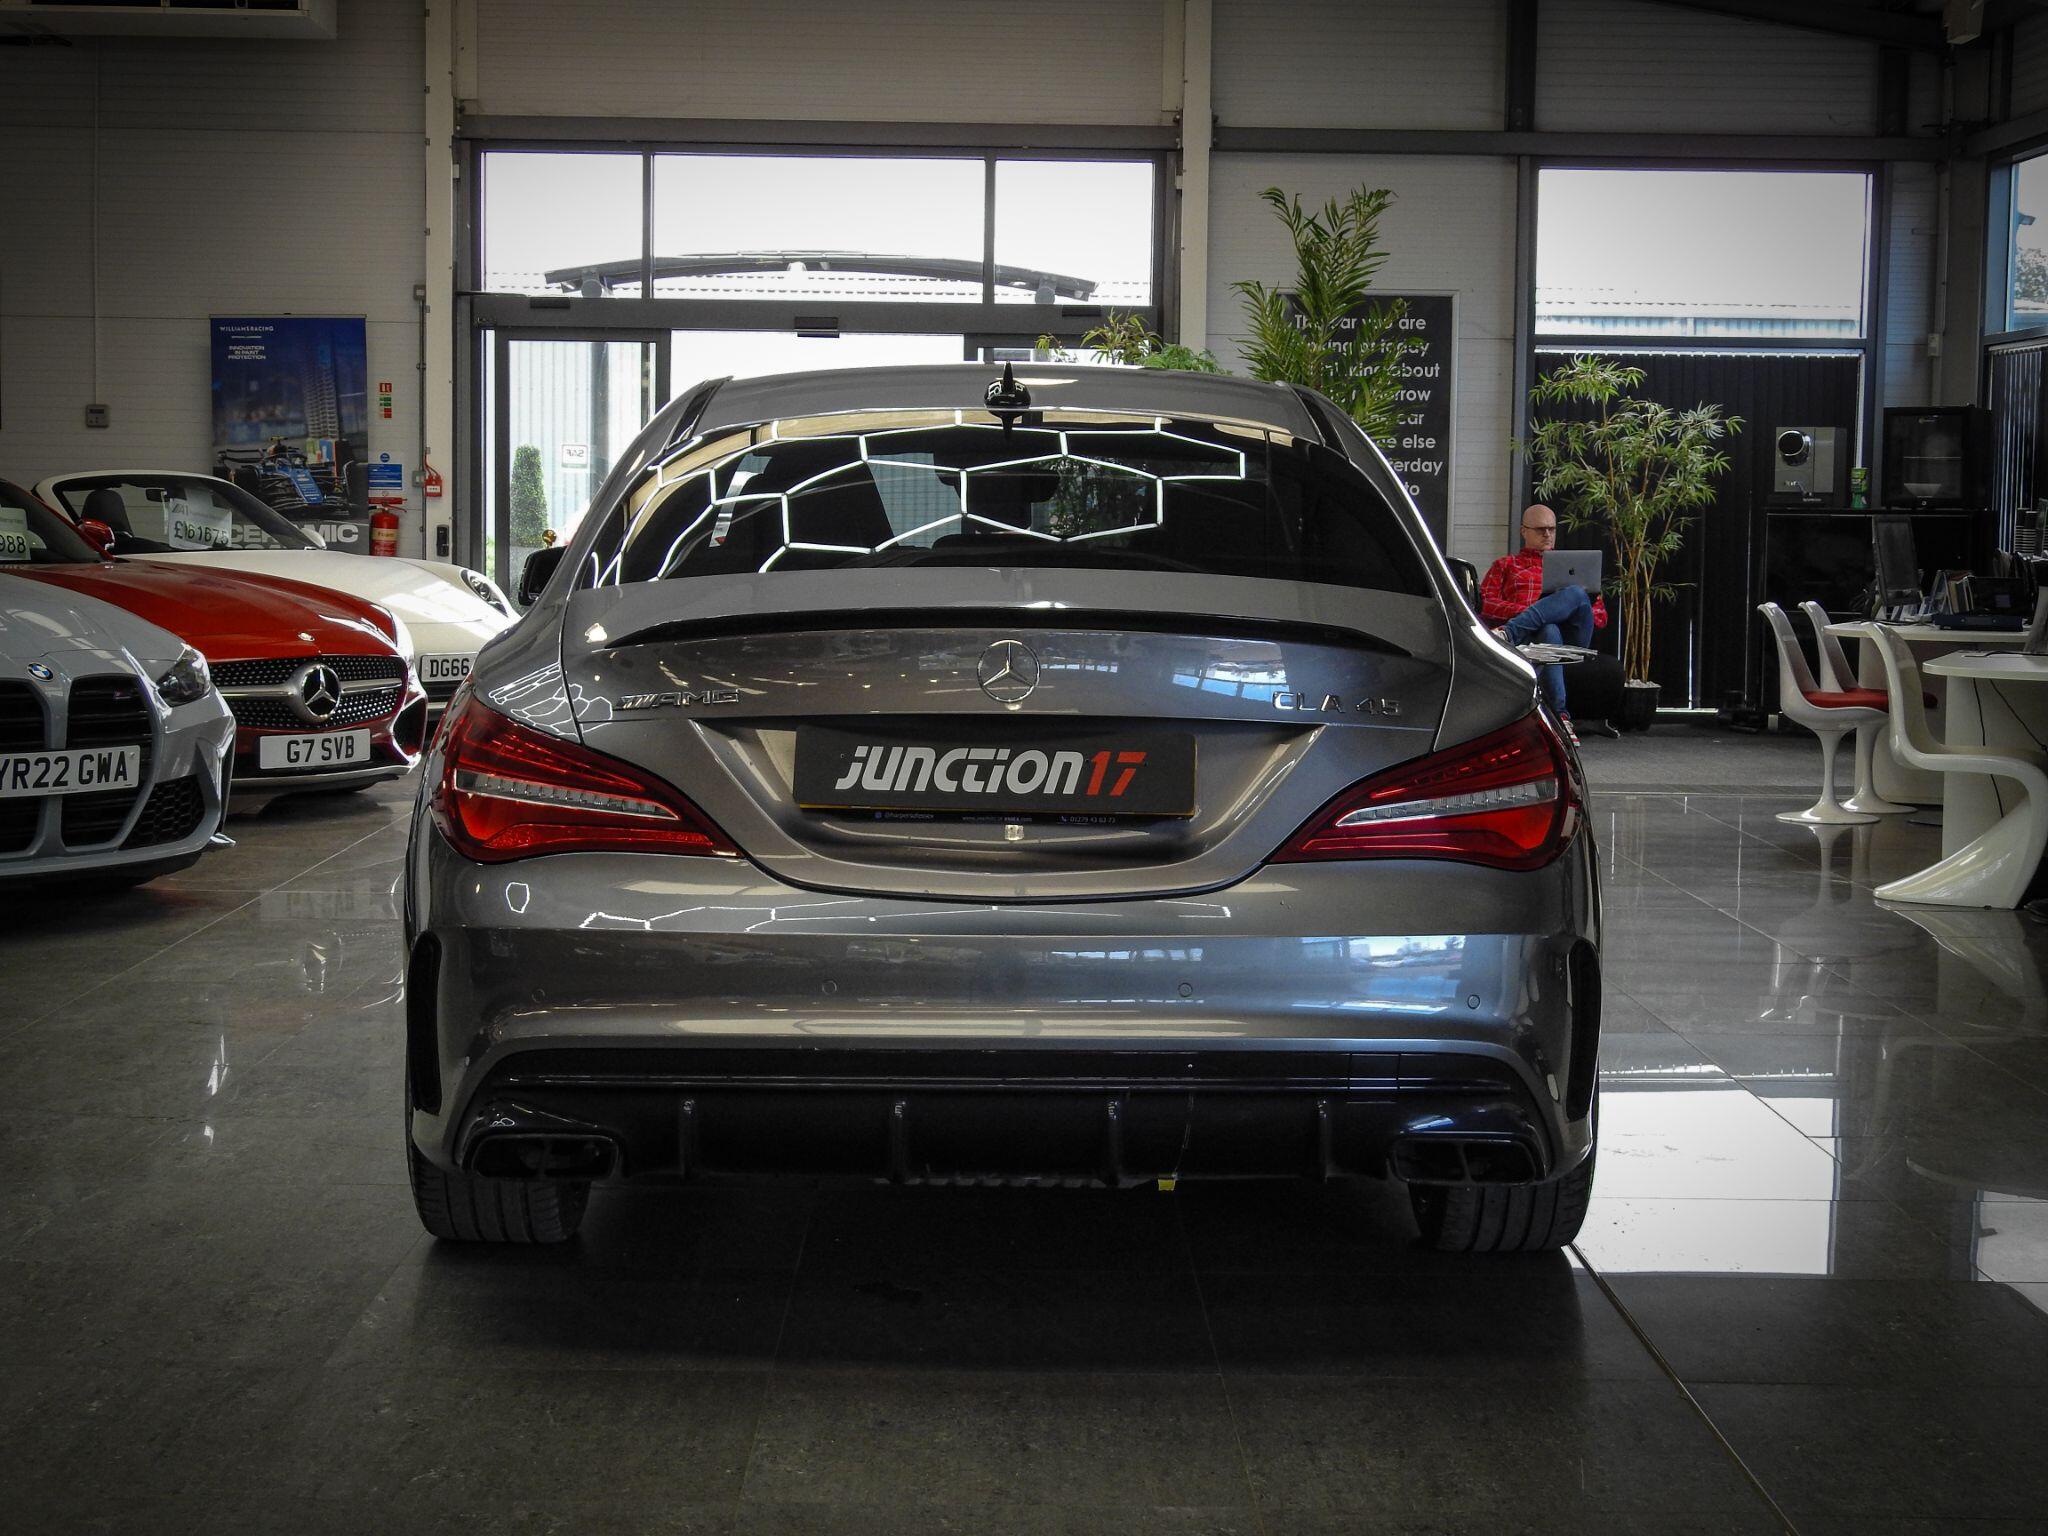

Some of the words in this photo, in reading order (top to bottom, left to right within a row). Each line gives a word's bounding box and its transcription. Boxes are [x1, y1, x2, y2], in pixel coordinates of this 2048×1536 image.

[1398, 317, 1427, 330] are
[1388, 362, 1441, 378] about
[1402, 434, 1437, 449] else
[429, 657, 470, 678] DG66
[1272, 691, 1346, 713] CLA
[1355, 697, 1401, 716] 45
[286, 739, 316, 763] G7
[321, 735, 355, 761] SVB
[78, 750, 128, 785] GWA
